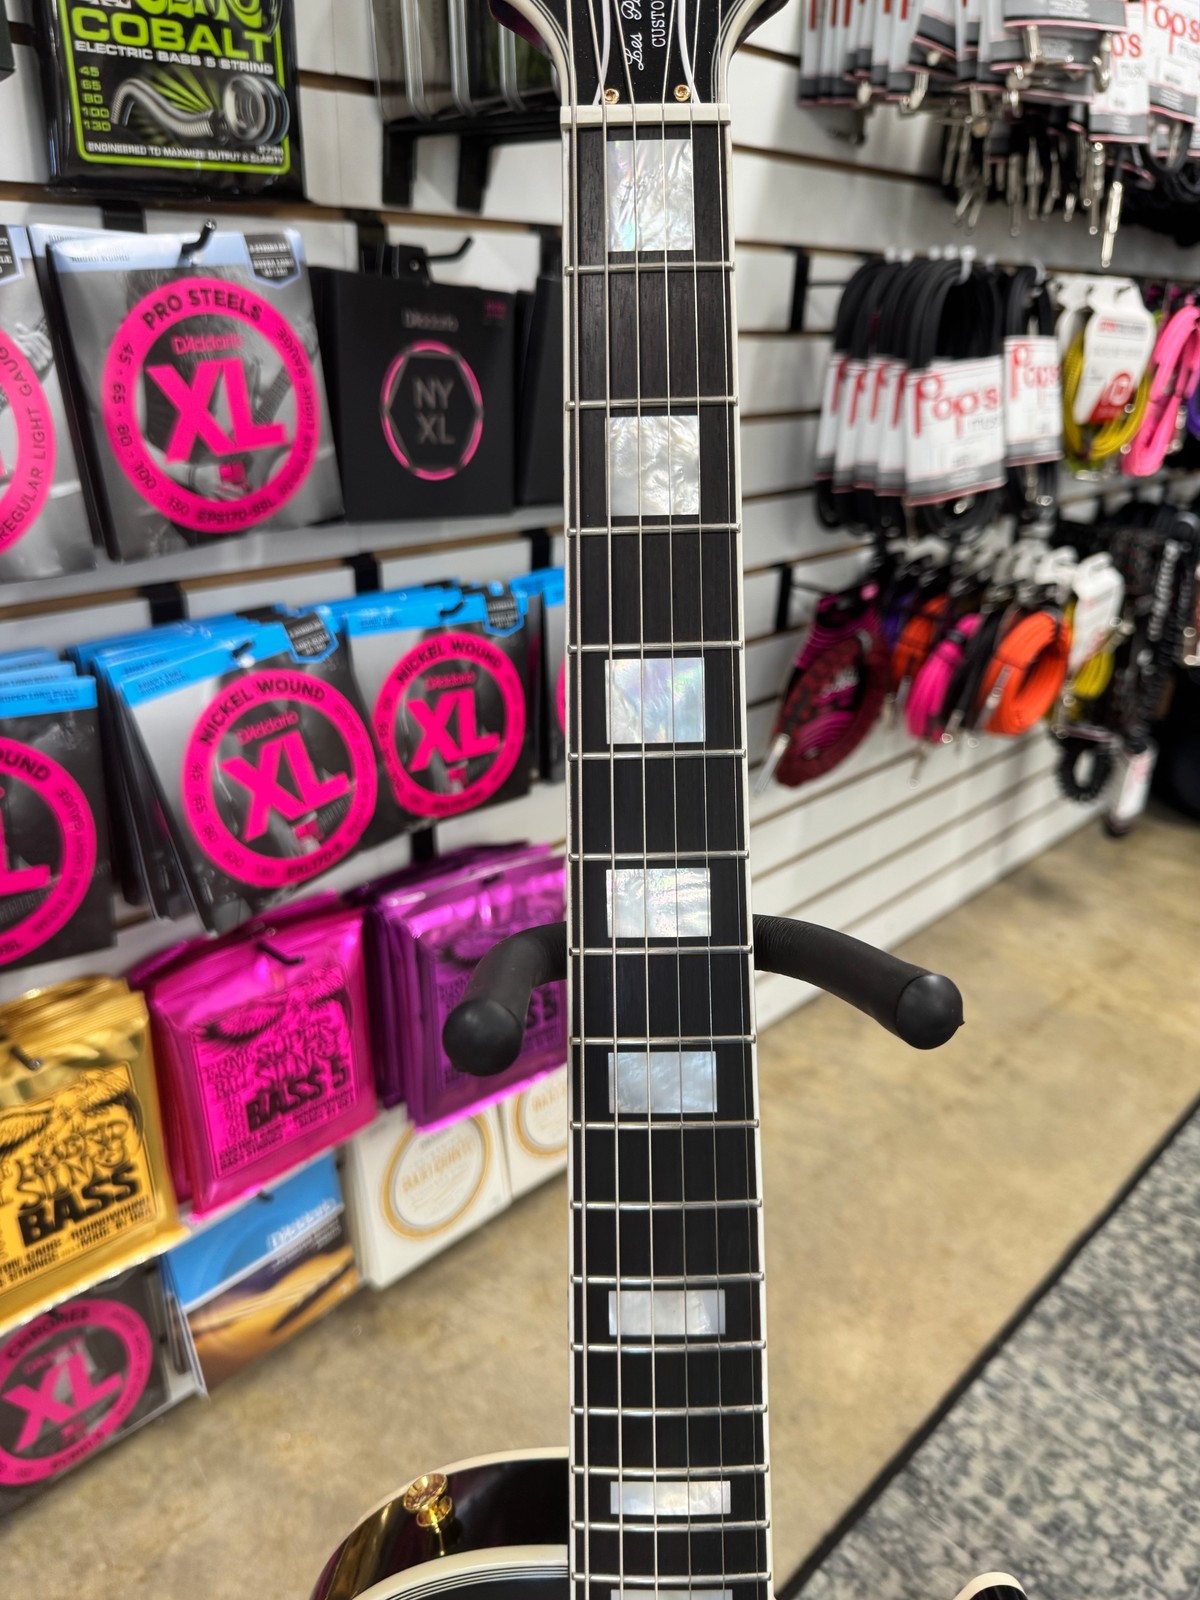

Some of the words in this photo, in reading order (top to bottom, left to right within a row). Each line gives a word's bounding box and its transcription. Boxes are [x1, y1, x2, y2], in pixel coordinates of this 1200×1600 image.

[71, 7, 273, 61] COBALT
[650, 0, 666, 48] CUSTO
[74, 41, 153, 60] ELECTRIC
[157, 51, 202, 66] BASS
[205, 56, 216, 69] 5
[220, 58, 275, 76] STRING
[79, 65, 100, 78] 45
[621, 32, 645, 71] Les
[82, 106, 110, 118] 100
[87, 141, 147, 156] ENGINEERED
[162, 146, 203, 159] MAXIMIZE
[141, 294, 183, 330] PRO
[188, 287, 263, 322] STEELS
[118, 343, 134, 365] 45
[112, 383, 126, 404] 65
[145, 357, 288, 465] XL
[413, 377, 455, 410] NY
[27, 407, 46, 461] LIGHT
[417, 411, 456, 444] XL
[131, 461, 158, 490] 100
[0, 466, 44, 542] REGULAR
[396, 641, 443, 685] NICKEL
[451, 639, 503, 670] WOUND
[199, 688, 254, 746] NICKEL
[256, 678, 326, 702] WOUND
[405, 687, 501, 774] XL
[219, 728, 352, 843] XL
[246, 1065, 323, 1131] BASS
[18, 1163, 139, 1248] BASS
[2, 1351, 124, 1453] XL
